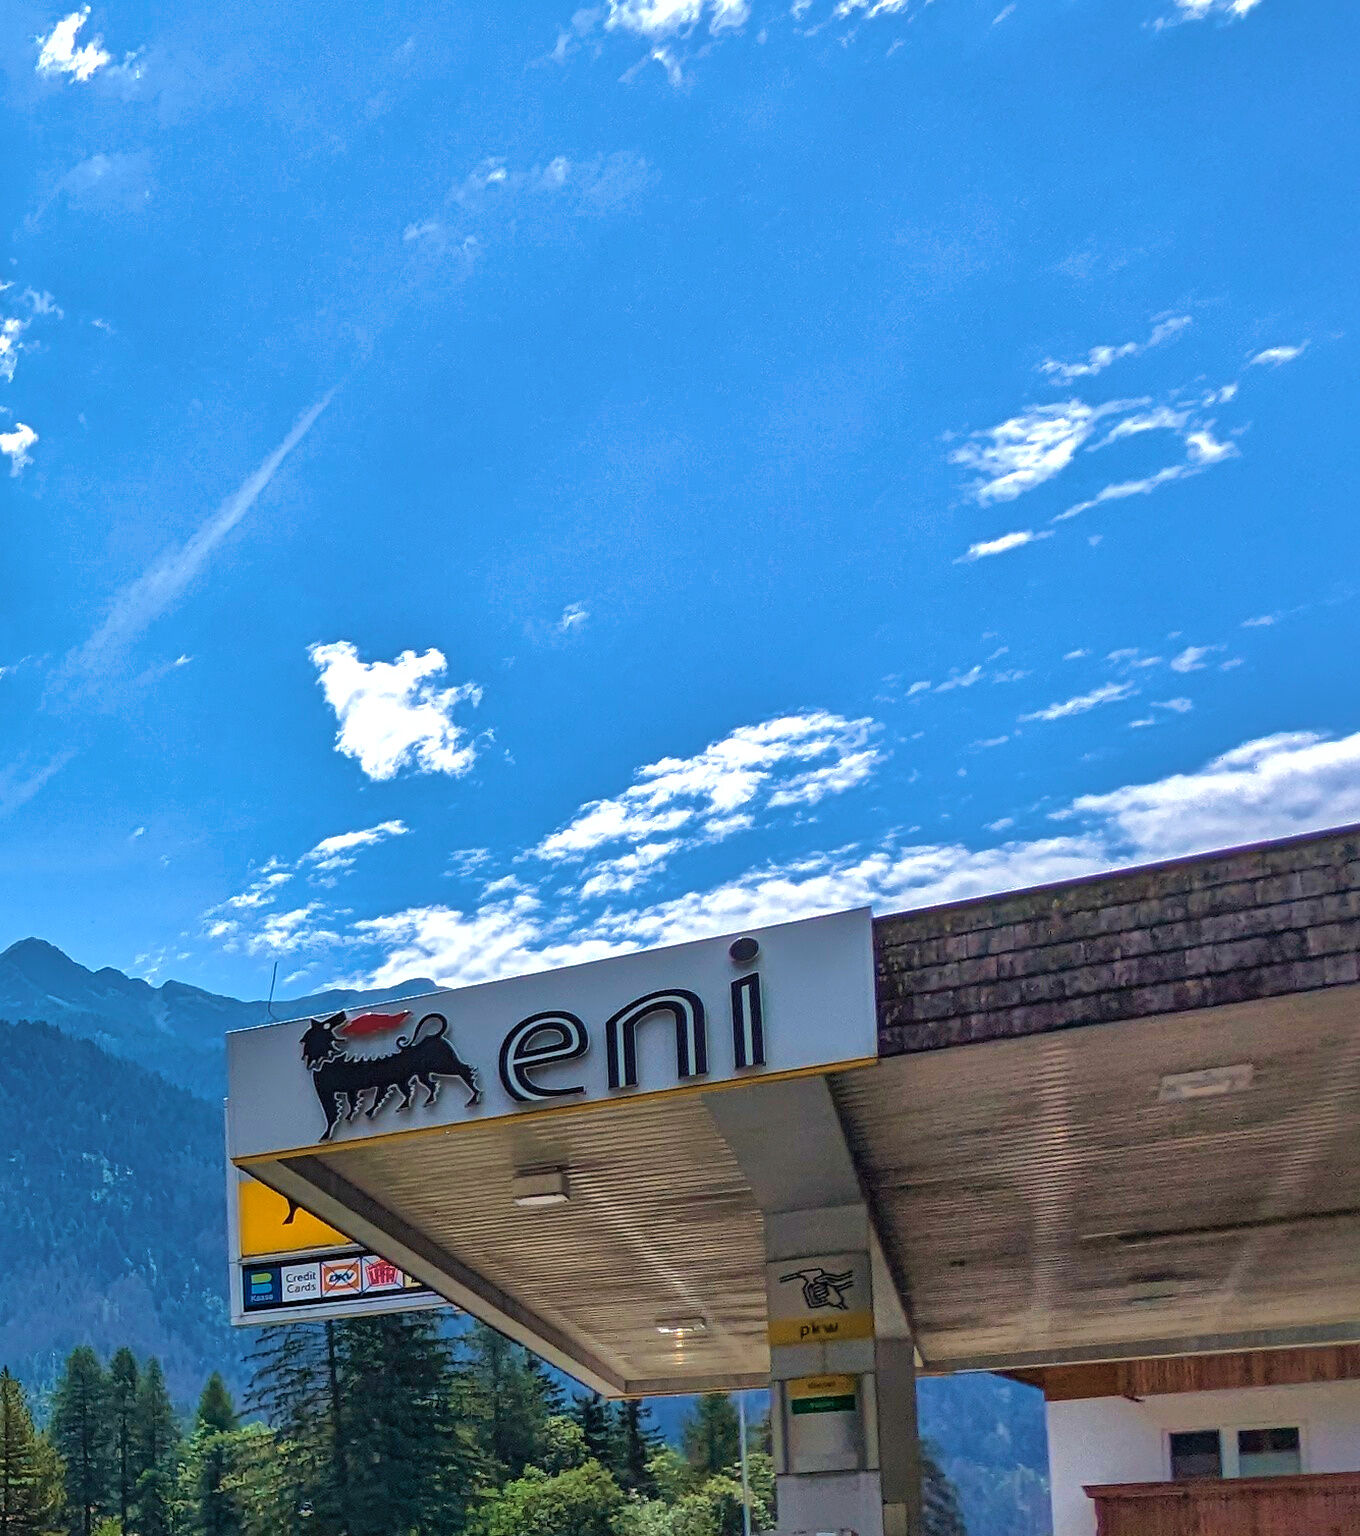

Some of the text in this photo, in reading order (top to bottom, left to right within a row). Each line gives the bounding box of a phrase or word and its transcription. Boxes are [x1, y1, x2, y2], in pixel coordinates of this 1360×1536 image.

[498, 936, 767, 1102] eni
[285, 1271, 317, 1284] Credit
[286, 1283, 317, 1294] Cards
